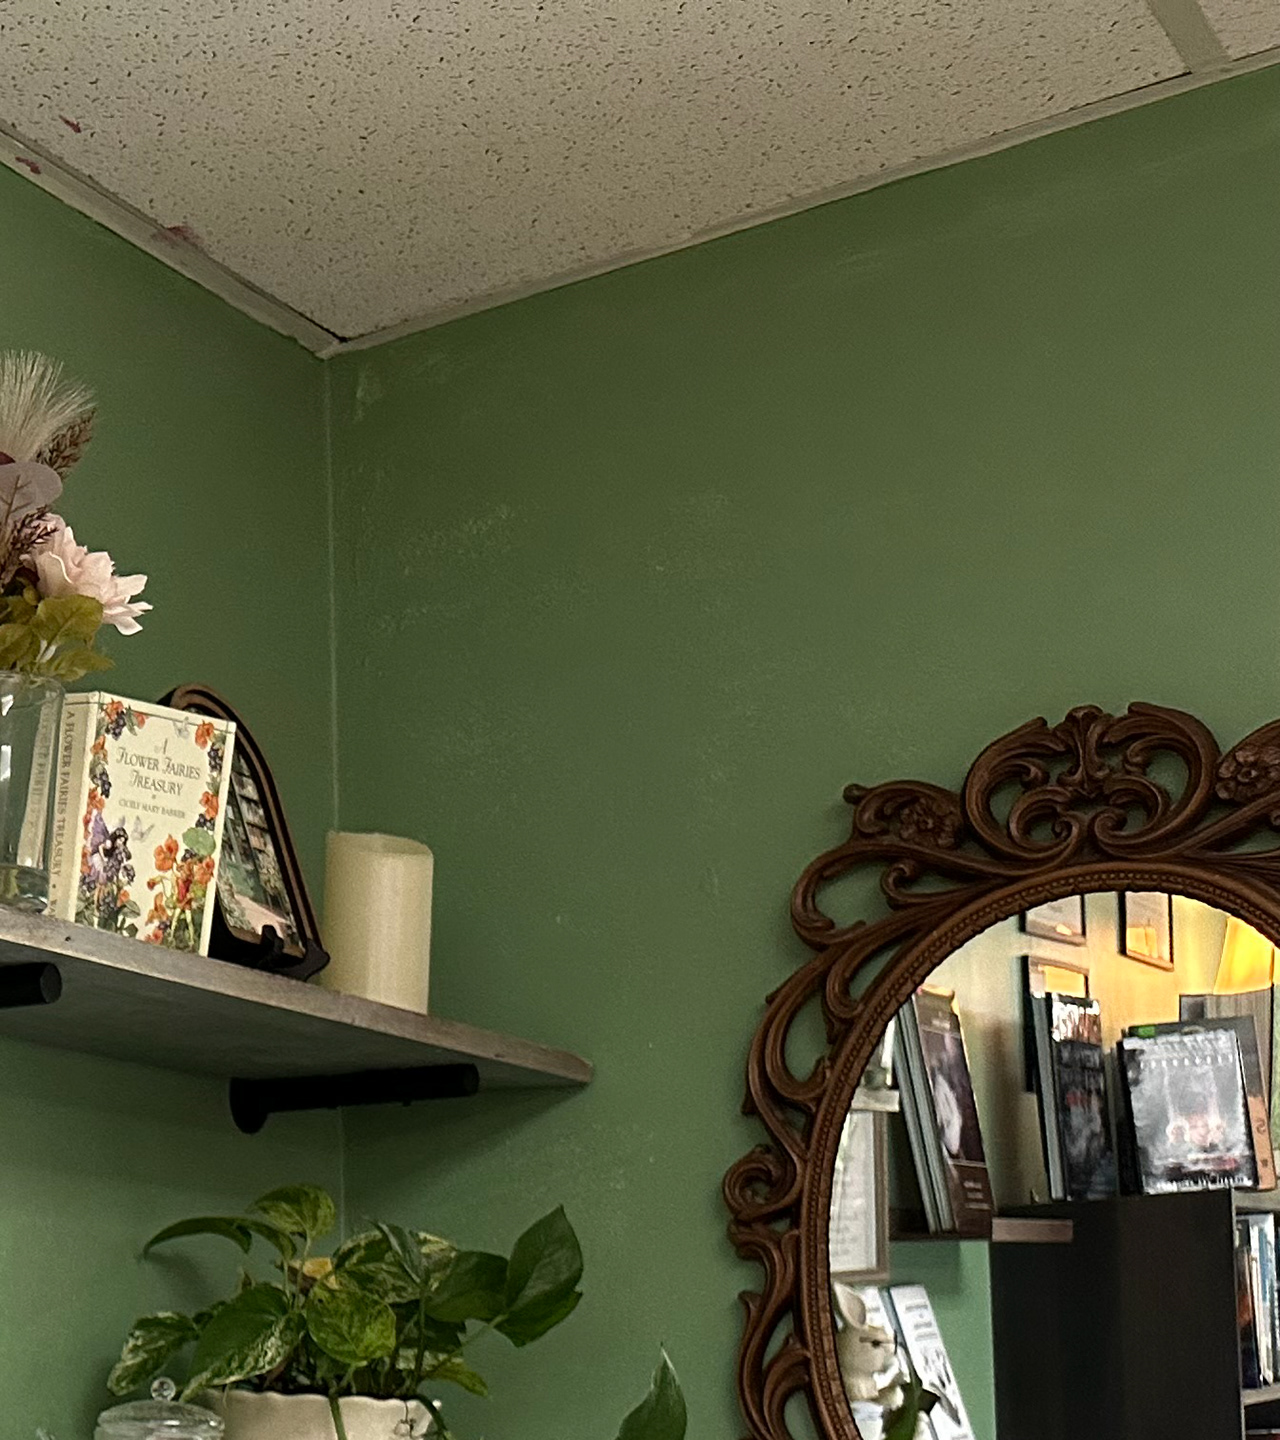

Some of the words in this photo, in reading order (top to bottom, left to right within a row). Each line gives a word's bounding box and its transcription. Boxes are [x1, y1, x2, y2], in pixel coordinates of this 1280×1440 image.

[115, 746, 160, 773] FLOWER
[161, 756, 201, 780] FAIRIES
[129, 769, 185, 797] TREASURY
